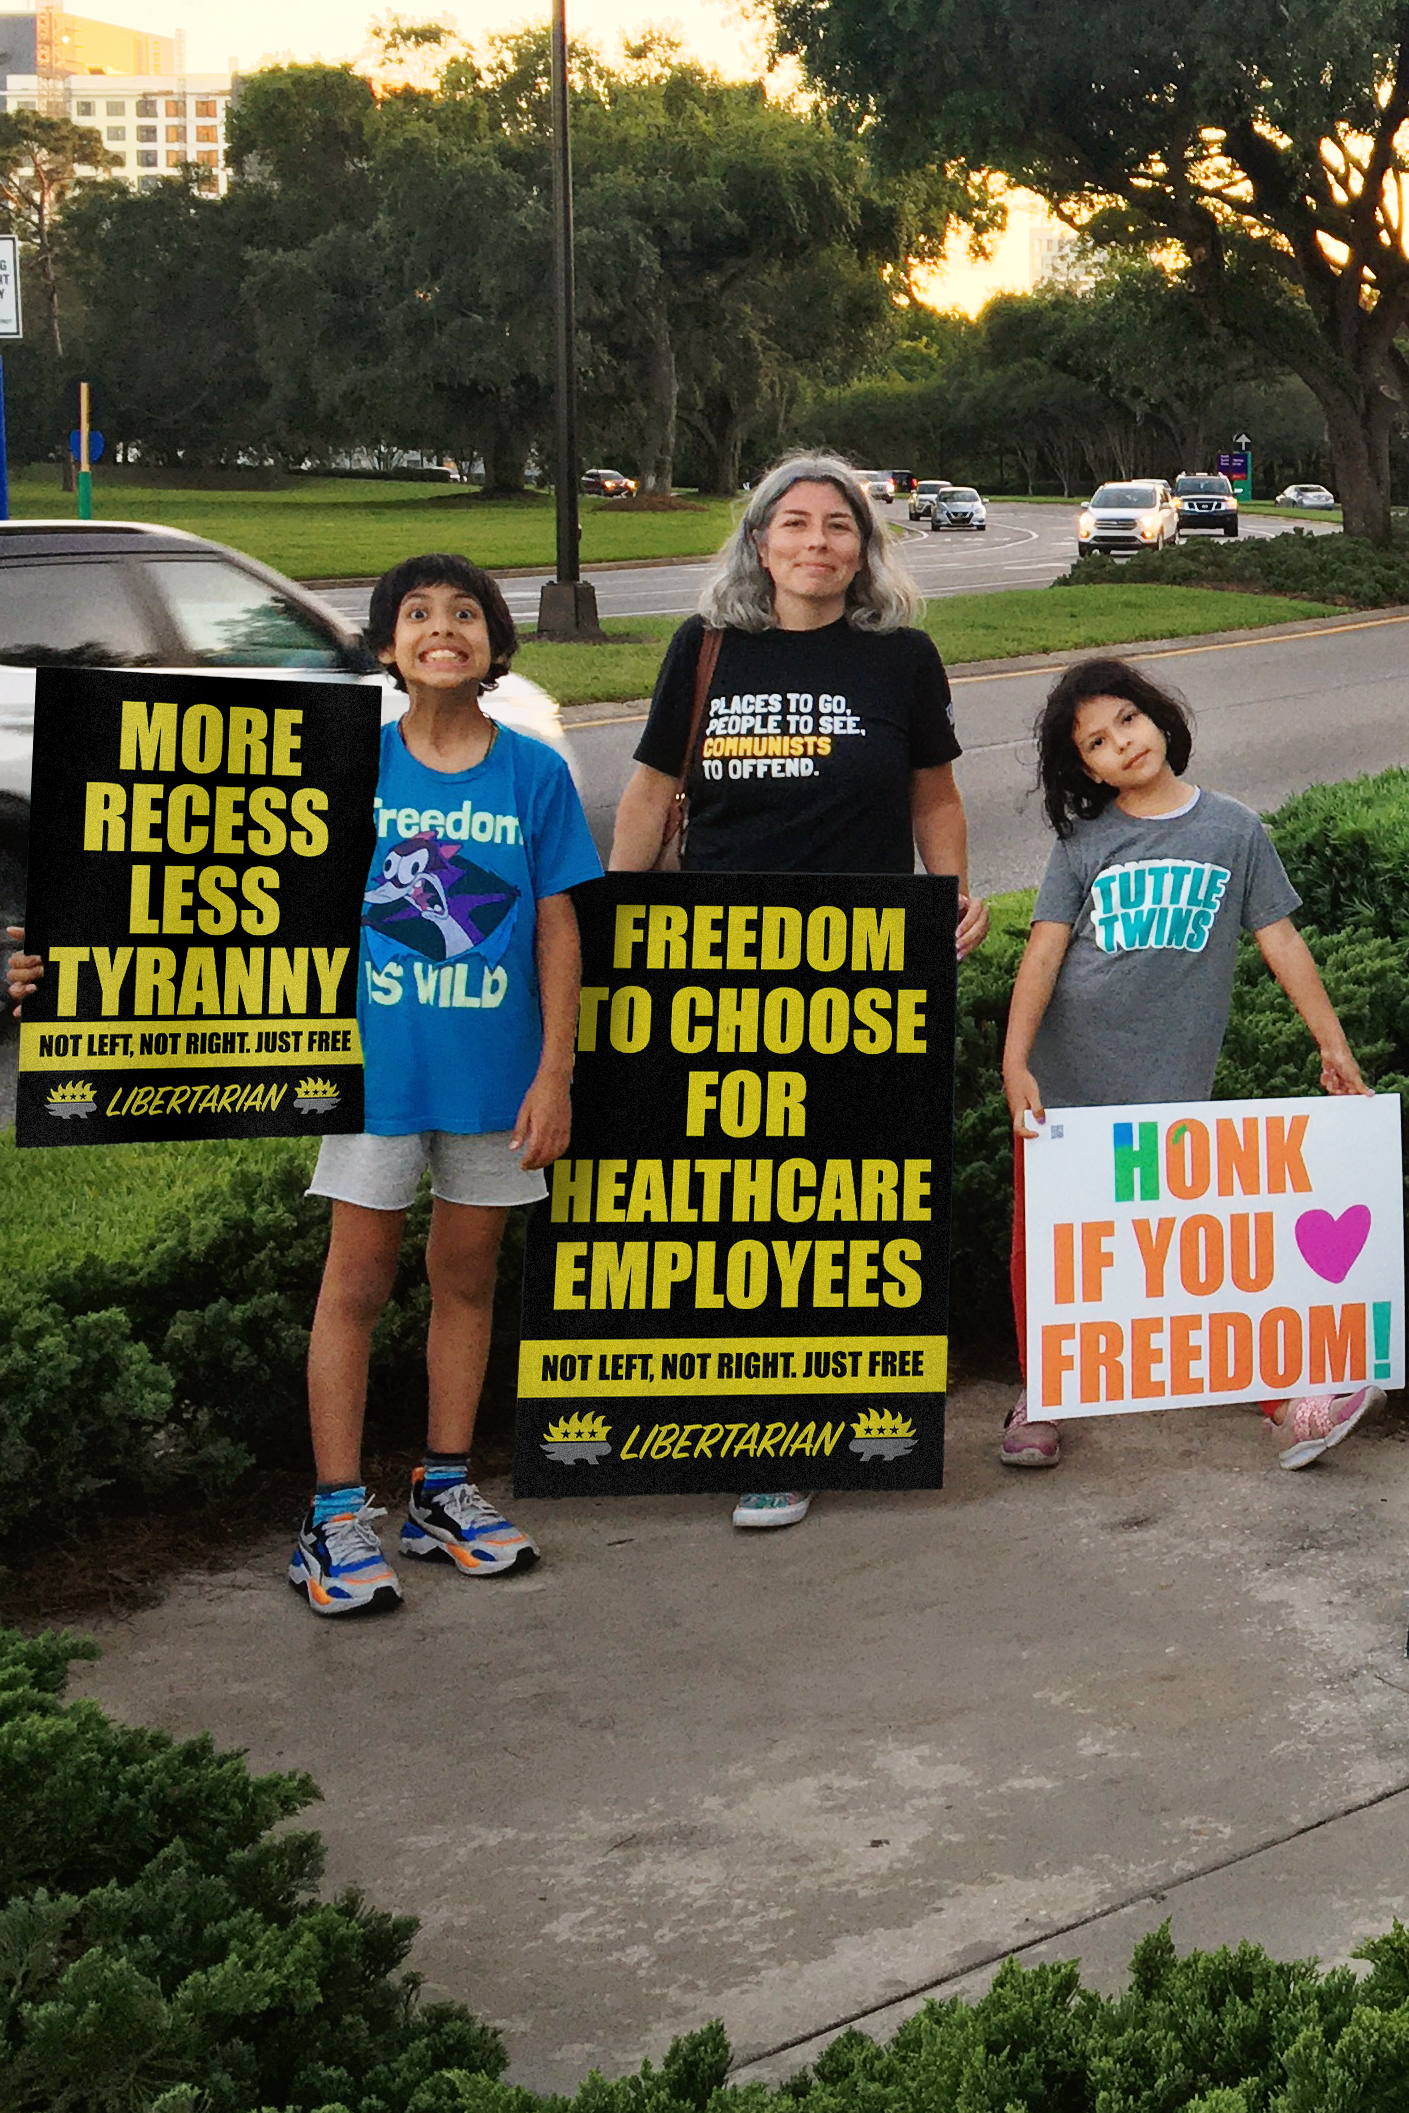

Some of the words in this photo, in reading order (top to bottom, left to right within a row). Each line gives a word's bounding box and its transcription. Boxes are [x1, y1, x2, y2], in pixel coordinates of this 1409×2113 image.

[706, 715, 781, 736] PEOPLE
[786, 715, 813, 734] TO
[818, 716, 866, 737] SEE,
[709, 694, 782, 716] PLACES
[786, 693, 813, 713] TO
[818, 694, 851, 716] GO,
[119, 701, 304, 776] MORE
[702, 736, 832, 758] COMMUNISTS
[702, 759, 723, 780] TO
[728, 758, 819, 779] OFFEND.
[83, 782, 329, 857] RECESS
[129, 865, 281, 935] LESS
[1094, 866, 1228, 914] TUTTLE
[613, 904, 906, 972] FREEDOM
[1098, 907, 1212, 953] TWINS
[48, 947, 351, 1017] TYRANNY
[39, 1034, 82, 1057] NOT
[88, 1034, 134, 1058] LEFT,
[139, 1033, 182, 1056] NOT
[185, 1032, 251, 1055] RIGHT.
[254, 1031, 304, 1053] JUST
[307, 1030, 352, 1052] FREE
[577, 986, 652, 1053] TO
[670, 986, 927, 1054] CHOOSE
[106, 1083, 288, 1118] LIBERTARIAN
[685, 1070, 807, 1138] FOR
[550, 1158, 932, 1223] HEALTHCARE
[1113, 1115, 1313, 1203] HONK
[553, 1239, 923, 1311] EMPLOYEES
[1053, 1221, 1115, 1305] IF
[1131, 1211, 1275, 1299] YOU
[541, 1354, 592, 1381] NOT
[598, 1354, 654, 1383] LEFT,
[661, 1353, 712, 1380] NOT
[717, 1352, 797, 1380] RIGHT.
[802, 1351, 863, 1379] JUST
[868, 1351, 924, 1377] FREE
[1041, 1301, 1392, 1407] FREEDOM!
[620, 1421, 846, 1461] LIBERTARIAN
